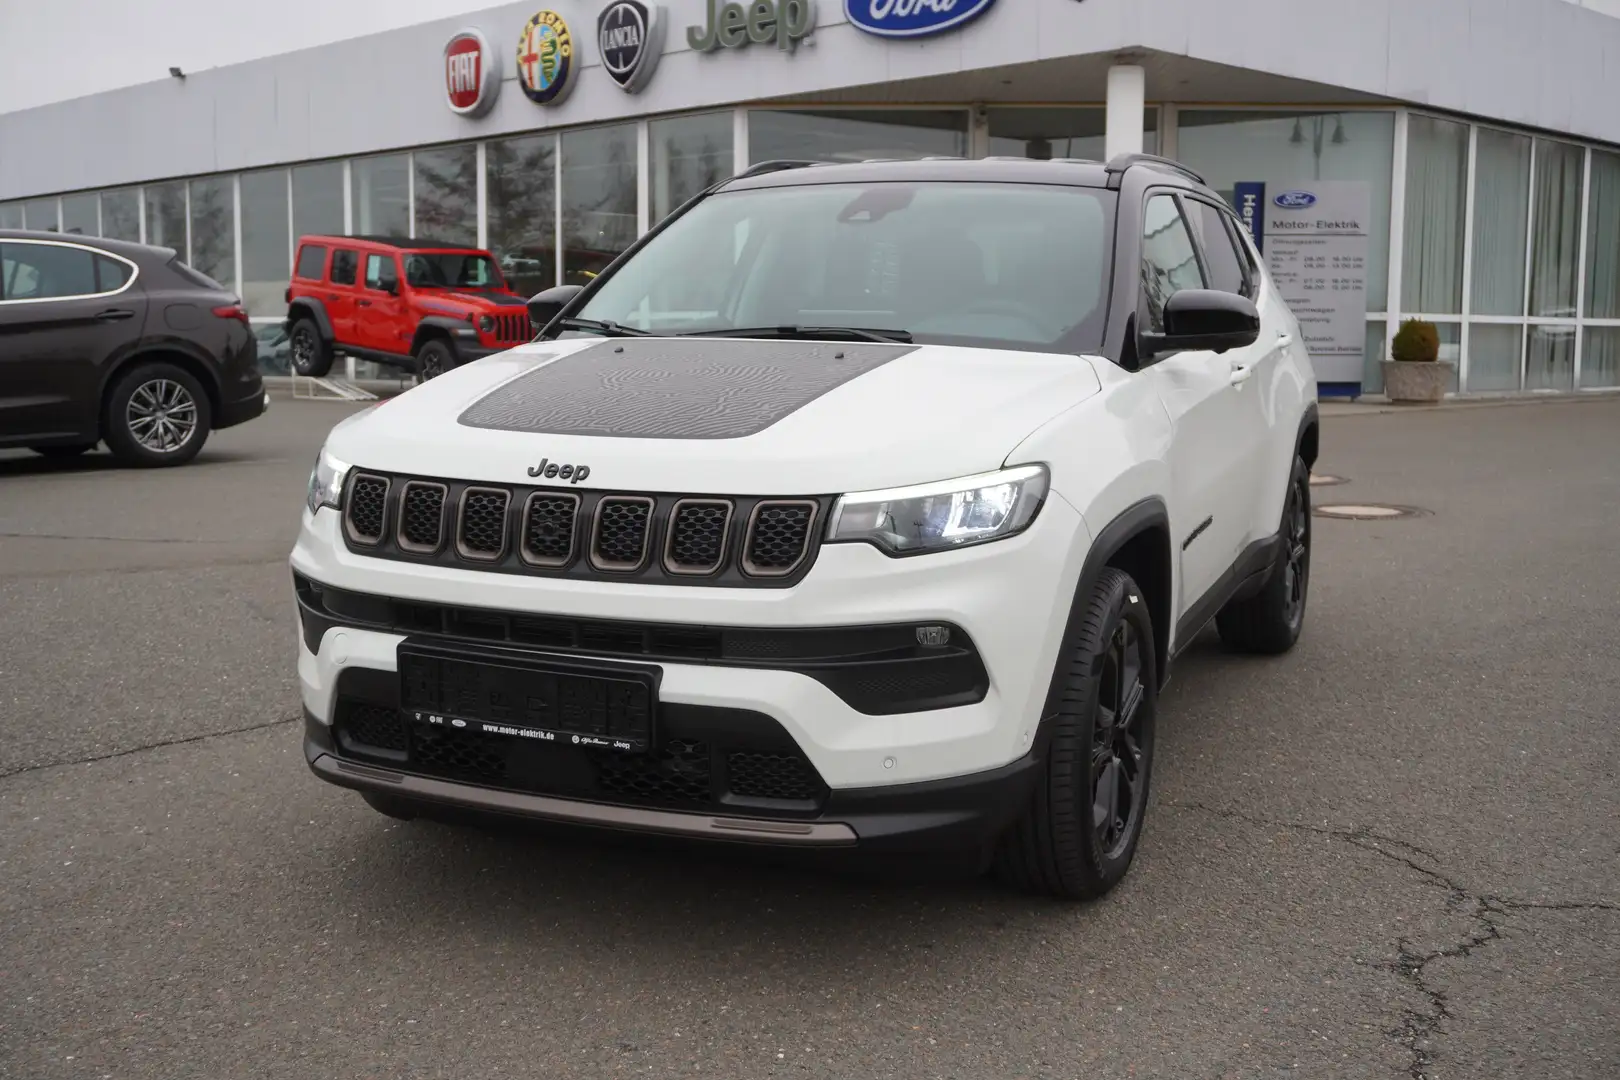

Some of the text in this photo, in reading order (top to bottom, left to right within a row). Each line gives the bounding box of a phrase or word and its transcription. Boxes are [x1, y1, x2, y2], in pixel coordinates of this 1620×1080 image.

[603, 24, 640, 50] LANCIA
[686, 0, 808, 52] Jeep
[448, 50, 479, 94] FIAT
[527, 457, 591, 484] Jeep
[482, 723, 555, 741] www.motor-elektrik.de
[613, 740, 631, 750] Jeep
